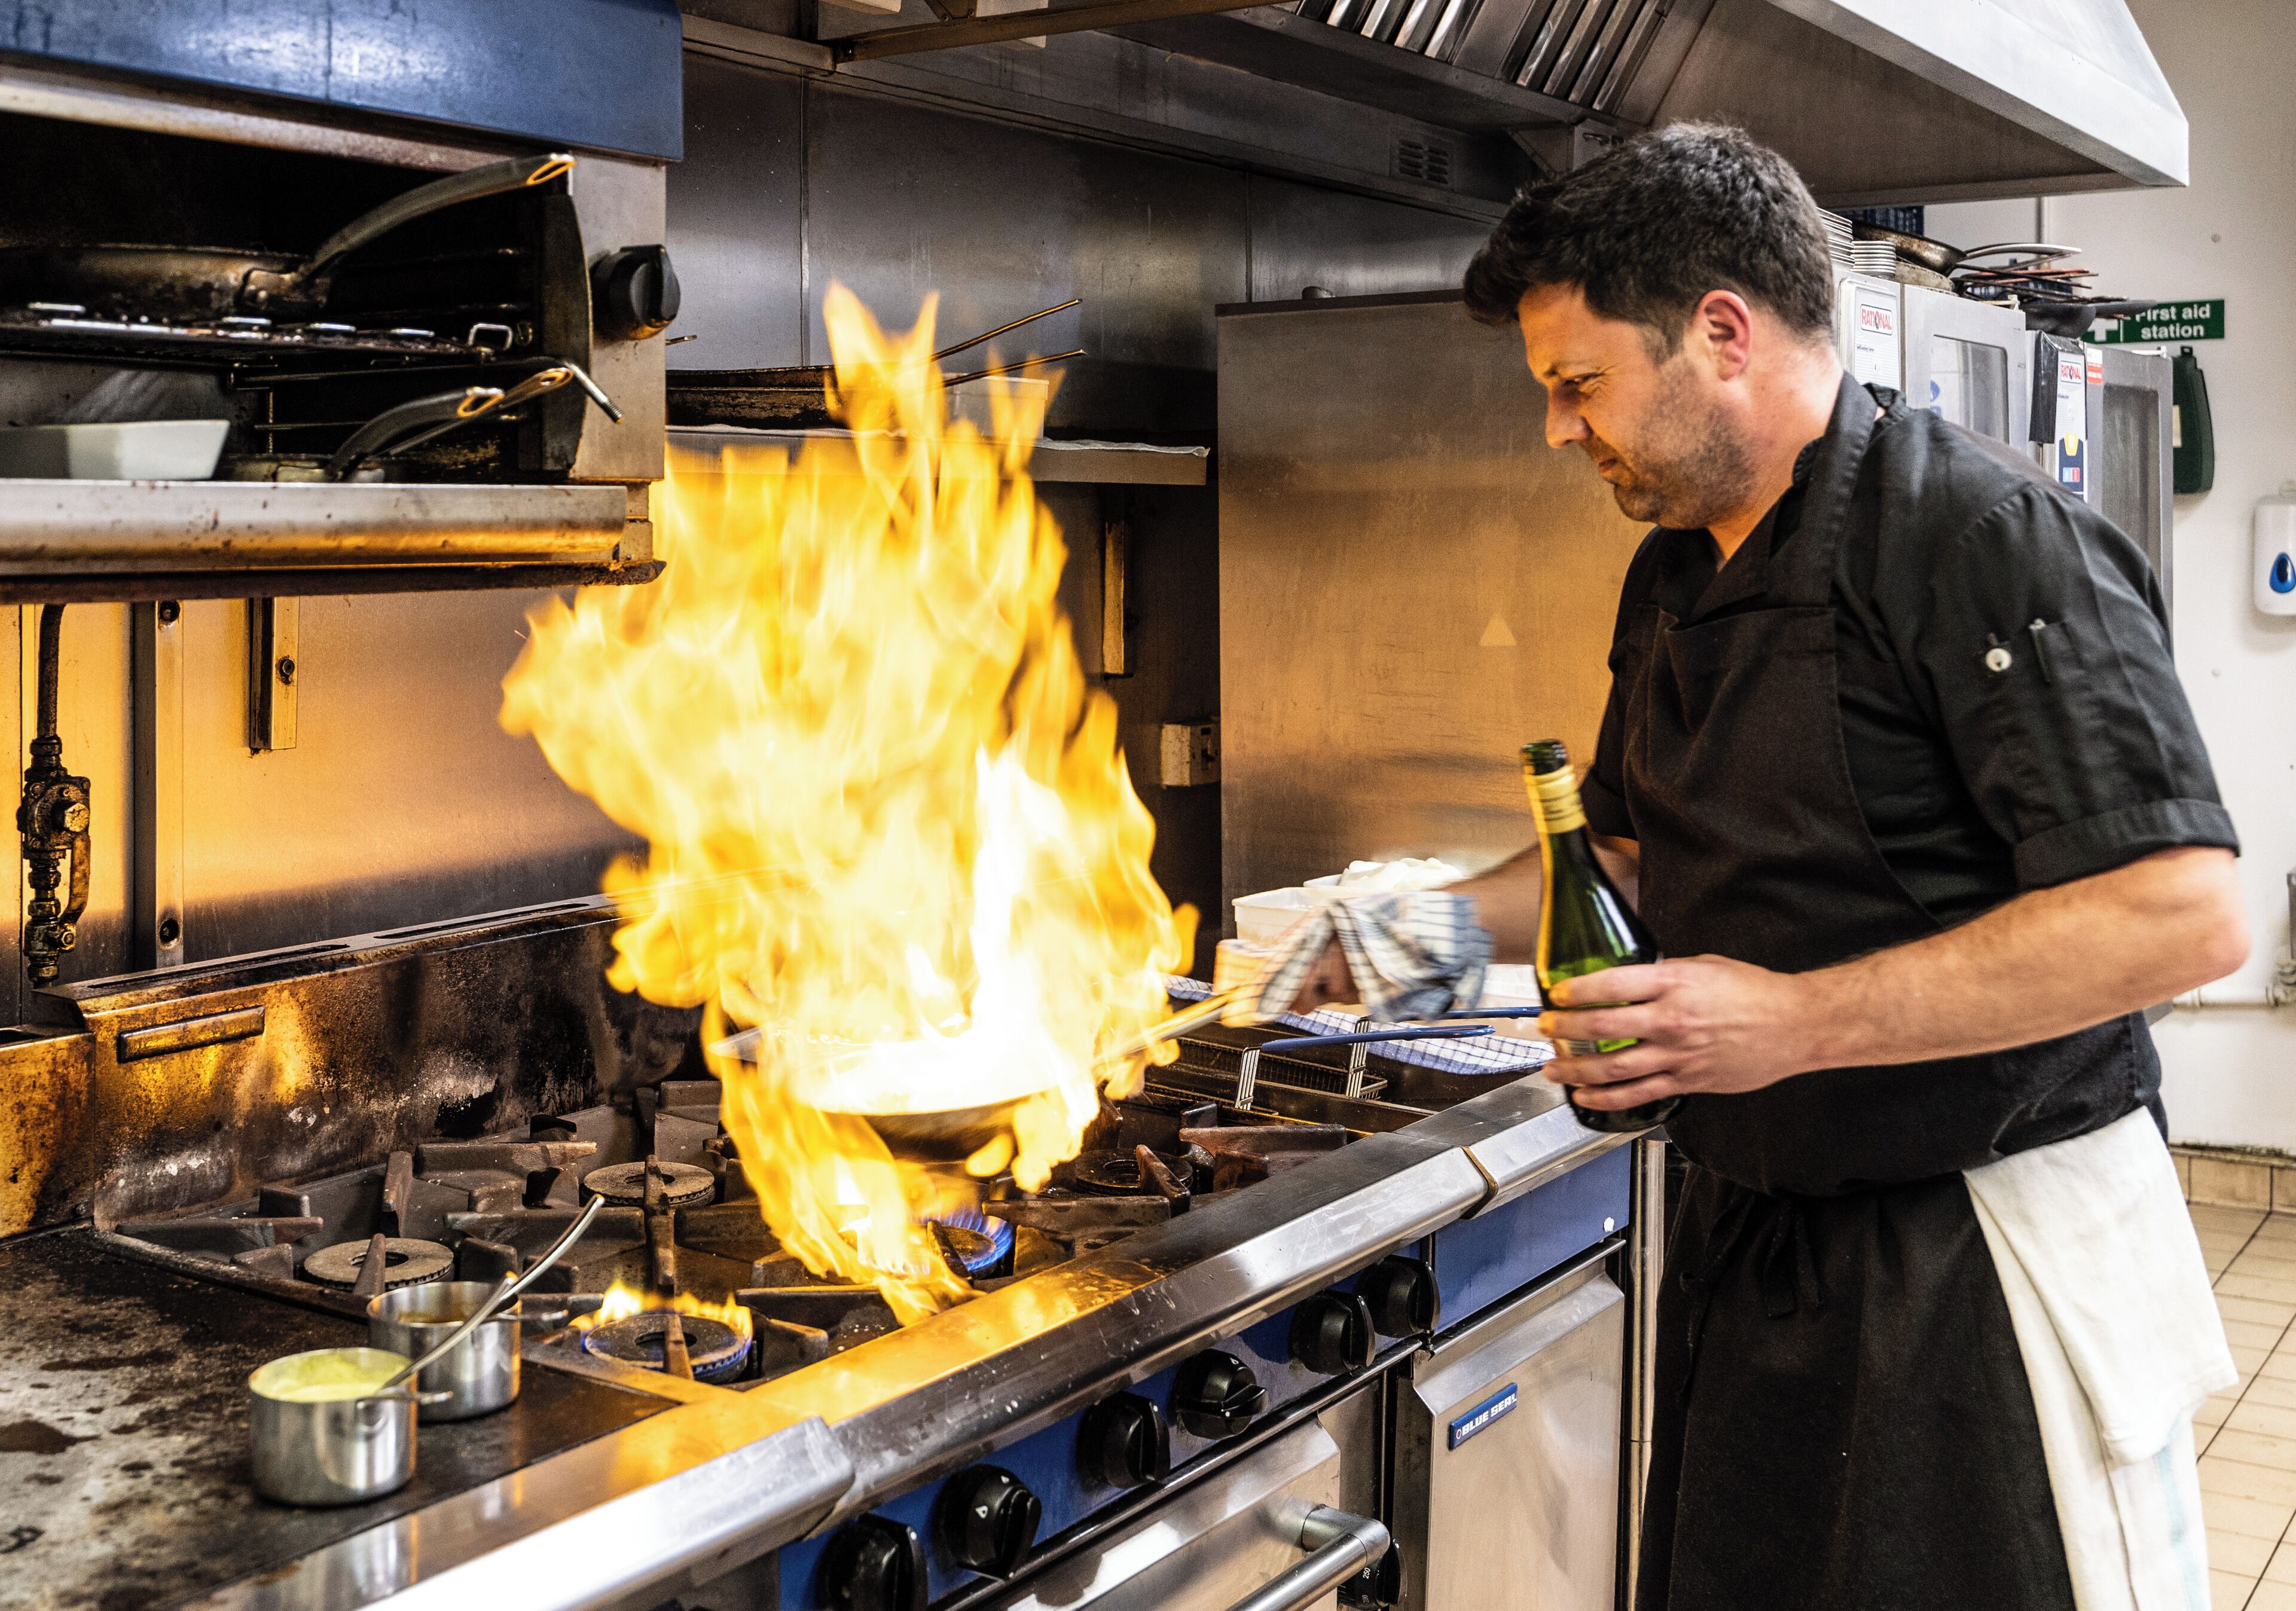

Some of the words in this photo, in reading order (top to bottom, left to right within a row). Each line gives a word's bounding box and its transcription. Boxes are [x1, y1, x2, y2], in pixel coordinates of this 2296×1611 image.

[1861, 308, 1892, 330] RATIONAL
[2182, 304, 2210, 320] aid
[2141, 323, 2205, 340] station
[1462, 1411, 1489, 1436] BLUE
[1491, 1393, 1517, 1417] SEAL
